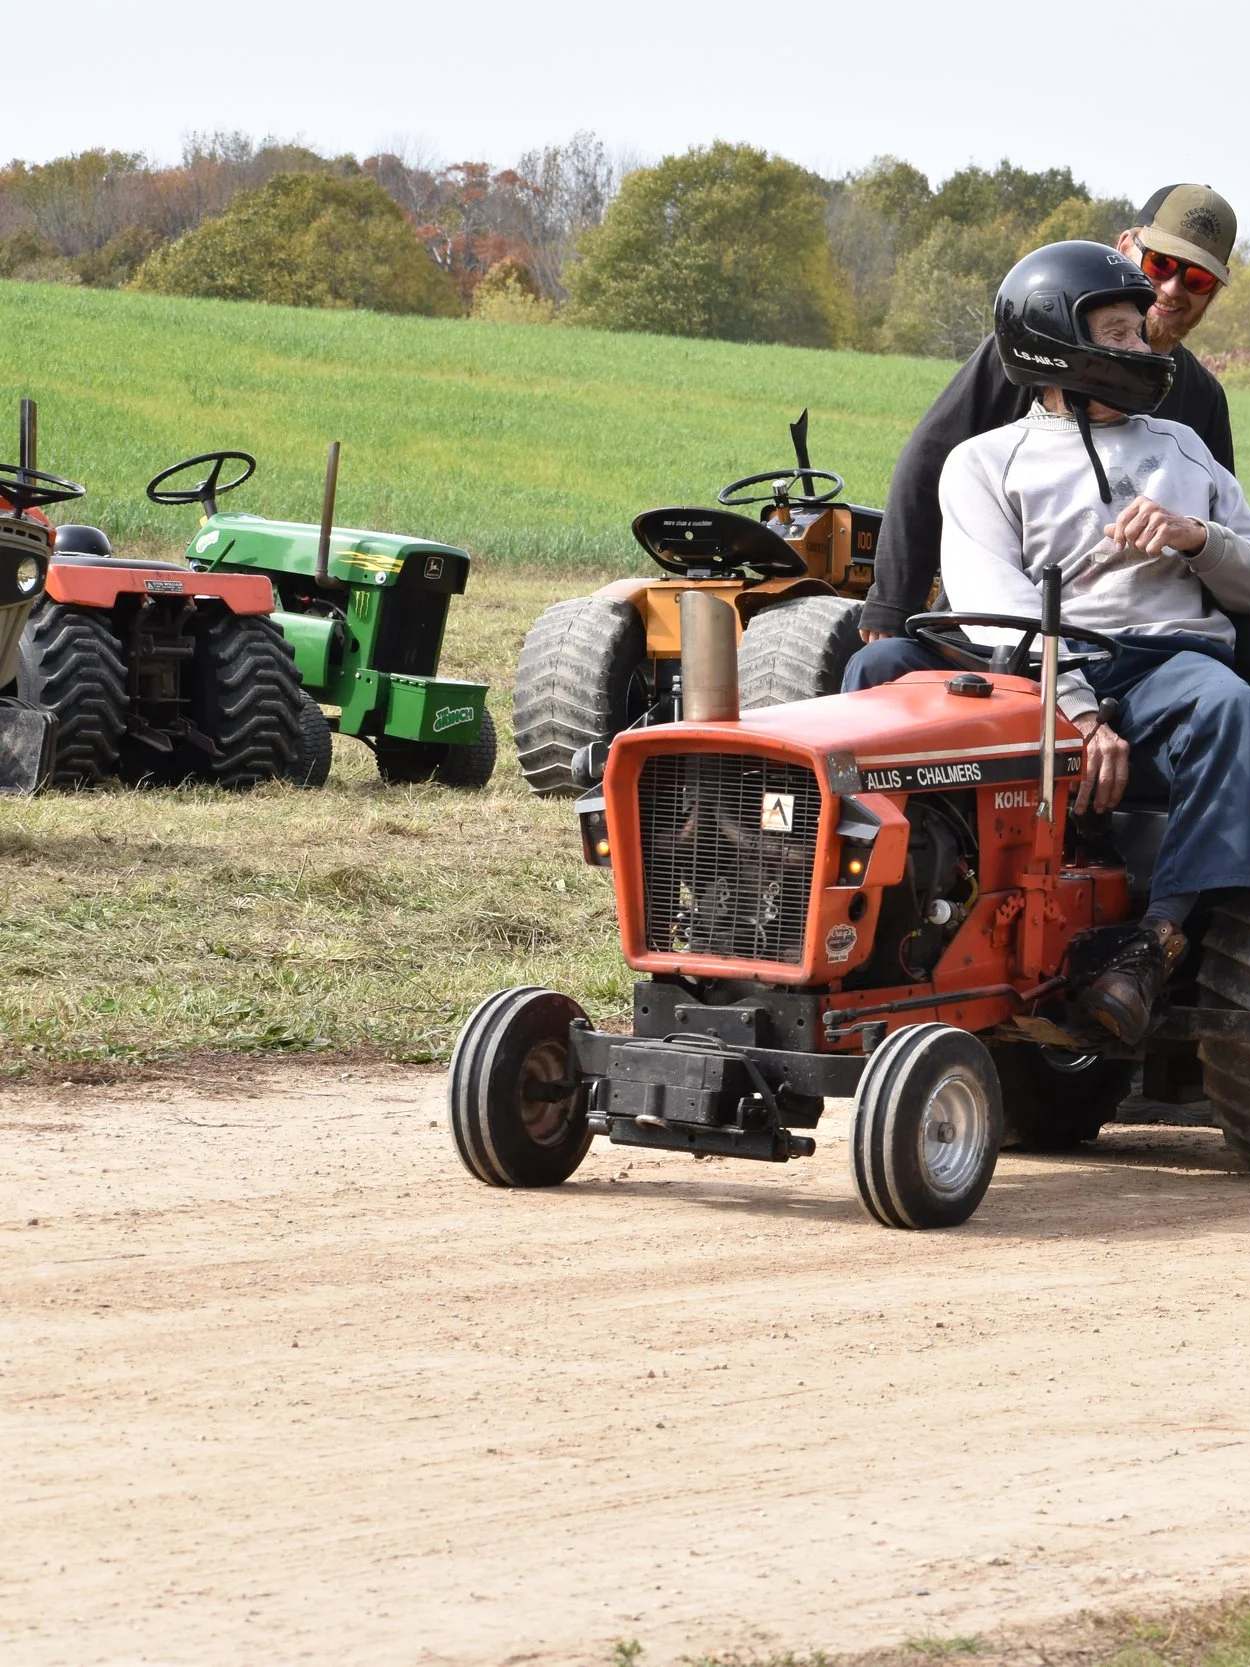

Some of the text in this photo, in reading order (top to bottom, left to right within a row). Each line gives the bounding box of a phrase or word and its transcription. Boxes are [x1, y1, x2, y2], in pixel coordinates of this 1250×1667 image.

[857, 532, 872, 550] 100
[1067, 757, 1081, 772] 700
[868, 770, 901, 790] ALLIS
[917, 763, 982, 786] CHALMERS
[994, 789, 1038, 809] KOHLE
